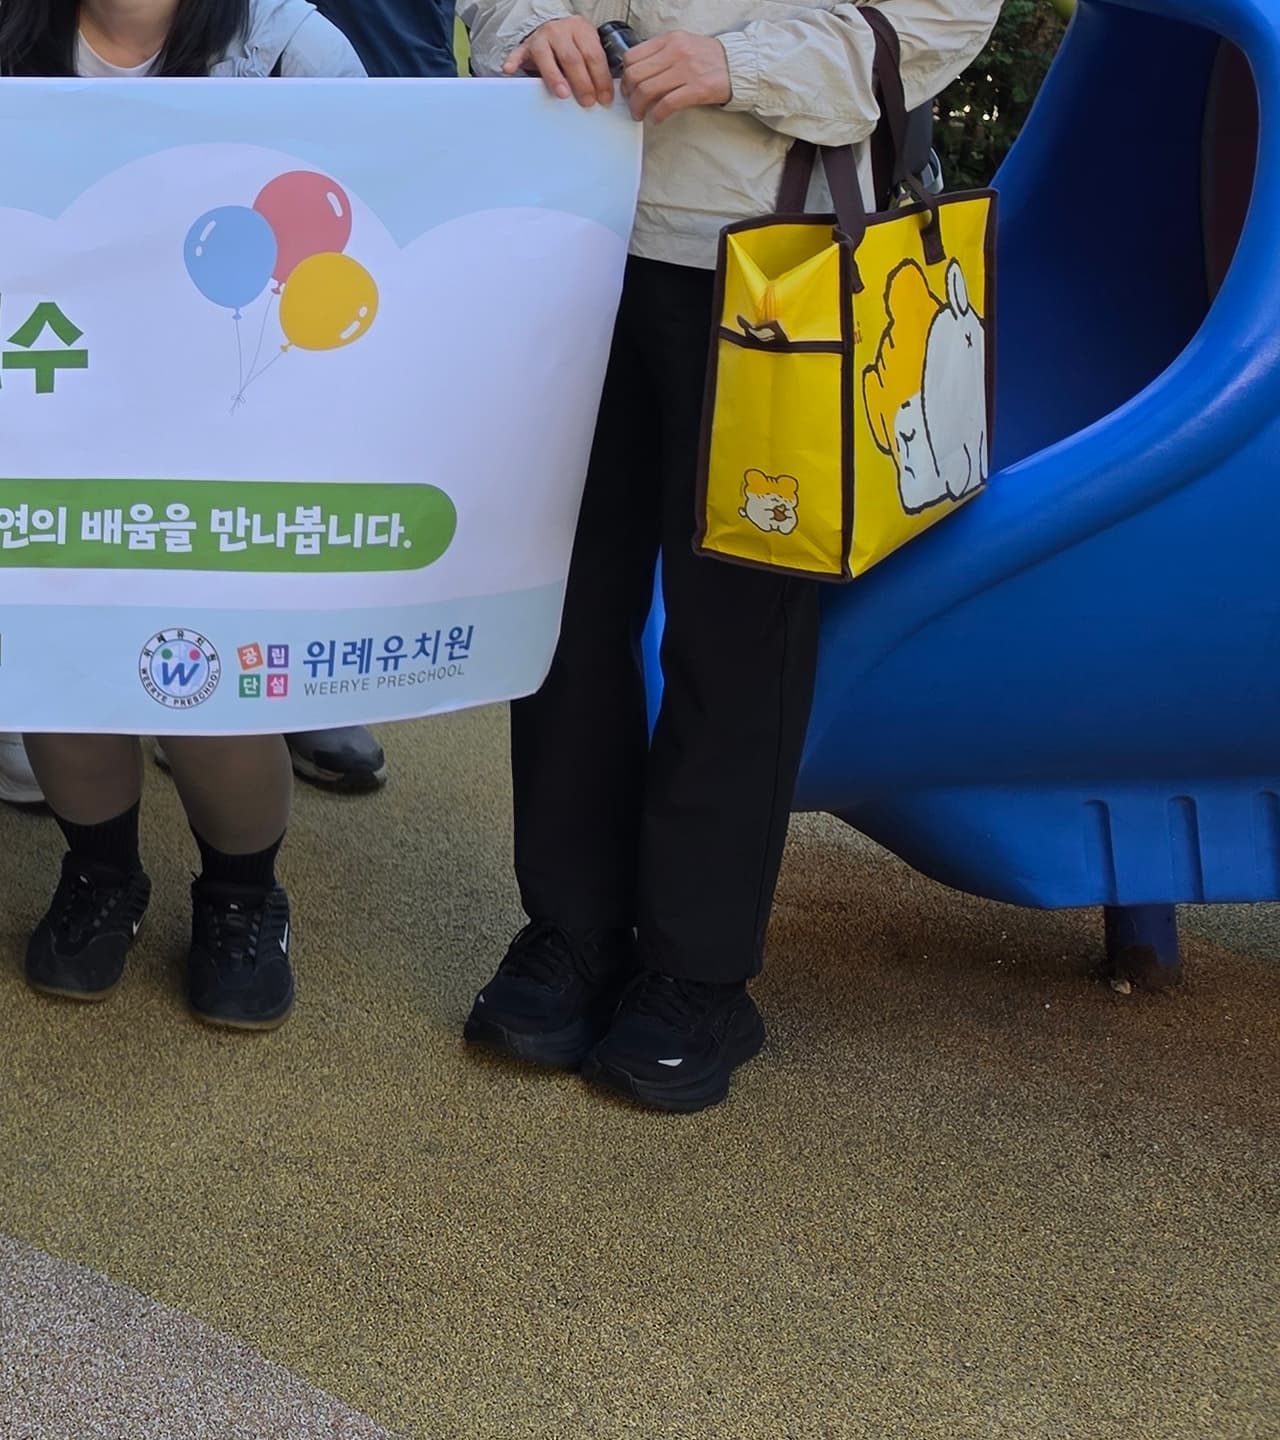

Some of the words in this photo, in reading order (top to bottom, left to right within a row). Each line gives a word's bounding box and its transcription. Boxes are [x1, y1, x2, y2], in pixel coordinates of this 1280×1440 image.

[81, 503, 196, 552] 배움을
[211, 506, 411, 555] 만나봅니다.
[241, 645, 287, 668] 공립
[303, 625, 473, 681] 위례유치원
[242, 675, 286, 696] 단설
[304, 677, 370, 696] WEERYE
[377, 663, 465, 689] PRESCHOOL
